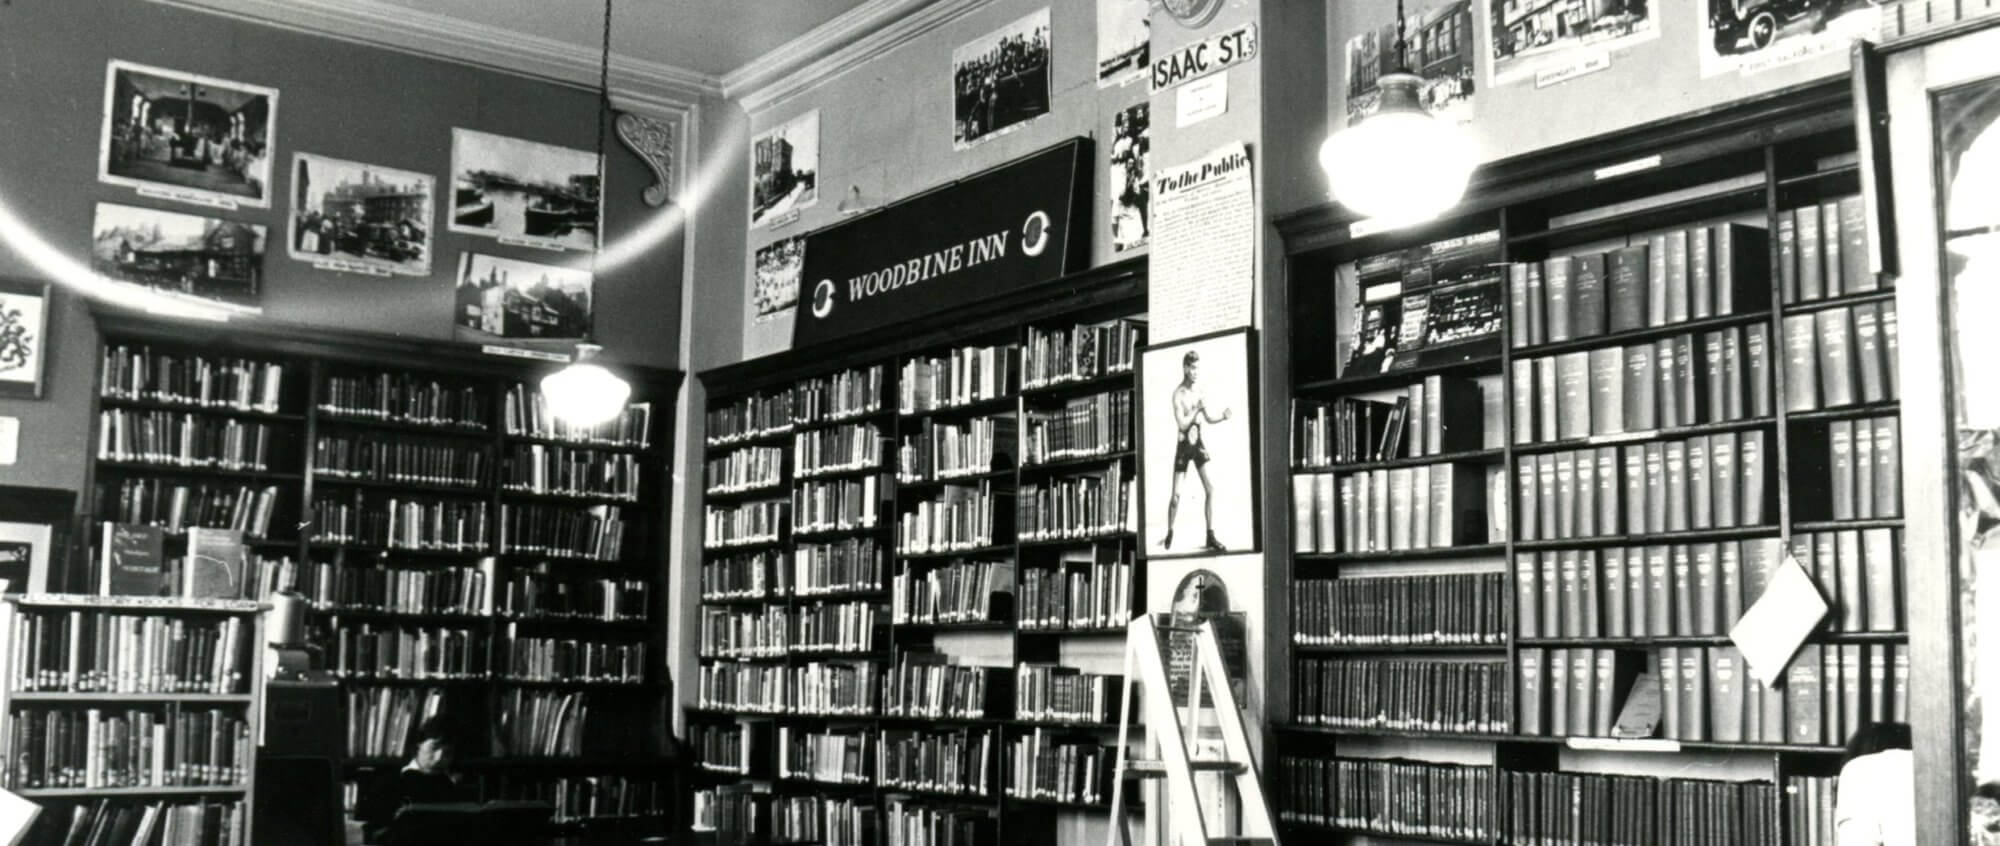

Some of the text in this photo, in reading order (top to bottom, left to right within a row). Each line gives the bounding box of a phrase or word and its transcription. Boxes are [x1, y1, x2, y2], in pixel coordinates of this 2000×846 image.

[1152, 43, 1208, 89] ISAAC
[1219, 30, 1247, 64] ST.
[1157, 153, 1248, 195] To the Public
[848, 230, 1009, 302] WOODBINE INN
